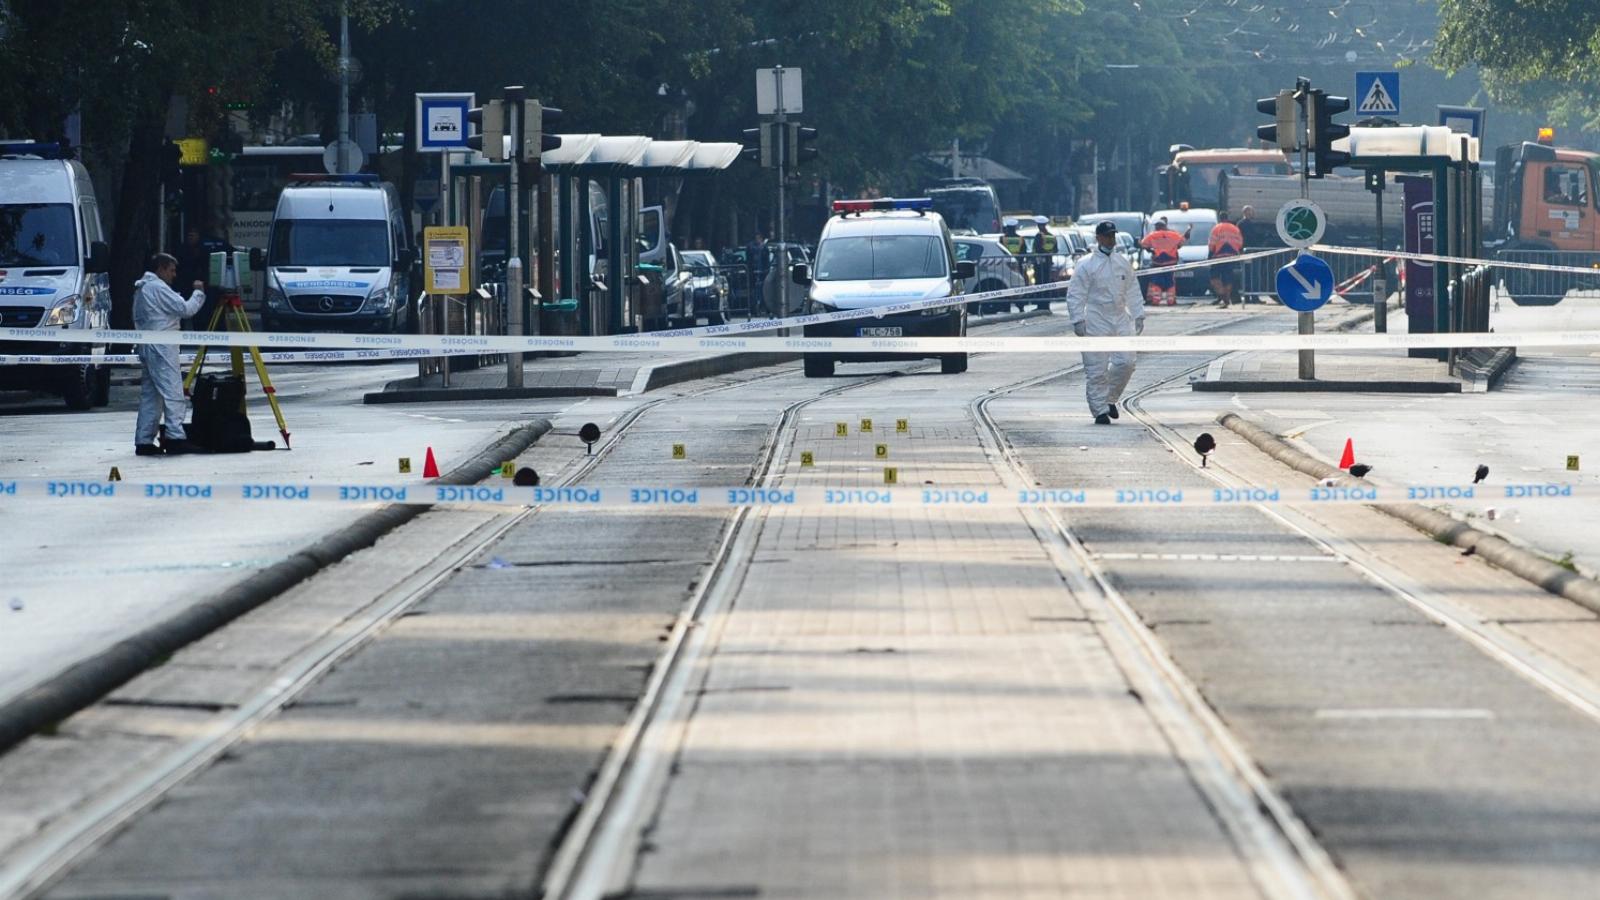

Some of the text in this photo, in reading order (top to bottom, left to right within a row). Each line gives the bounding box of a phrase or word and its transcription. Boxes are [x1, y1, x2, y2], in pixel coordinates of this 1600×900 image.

[48, 482, 116, 497] POLICE
[145, 483, 213, 499] POLICE
[242, 485, 310, 501] POLICE
[339, 486, 408, 503] POLICE
[436, 487, 505, 503] POLICE
[533, 488, 602, 504] POLICE
[630, 489, 699, 505] POLICE
[1115, 489, 1184, 504] POLICE
[1212, 488, 1281, 503] POLICE
[1309, 487, 1377, 502] POLICE
[1407, 486, 1475, 501] POLICE
[1504, 484, 1573, 498] POLICE
[728, 490, 797, 506] POLICE
[825, 490, 892, 505] POLICE
[922, 490, 990, 505] POLICE
[1018, 490, 1087, 505] POLICE
